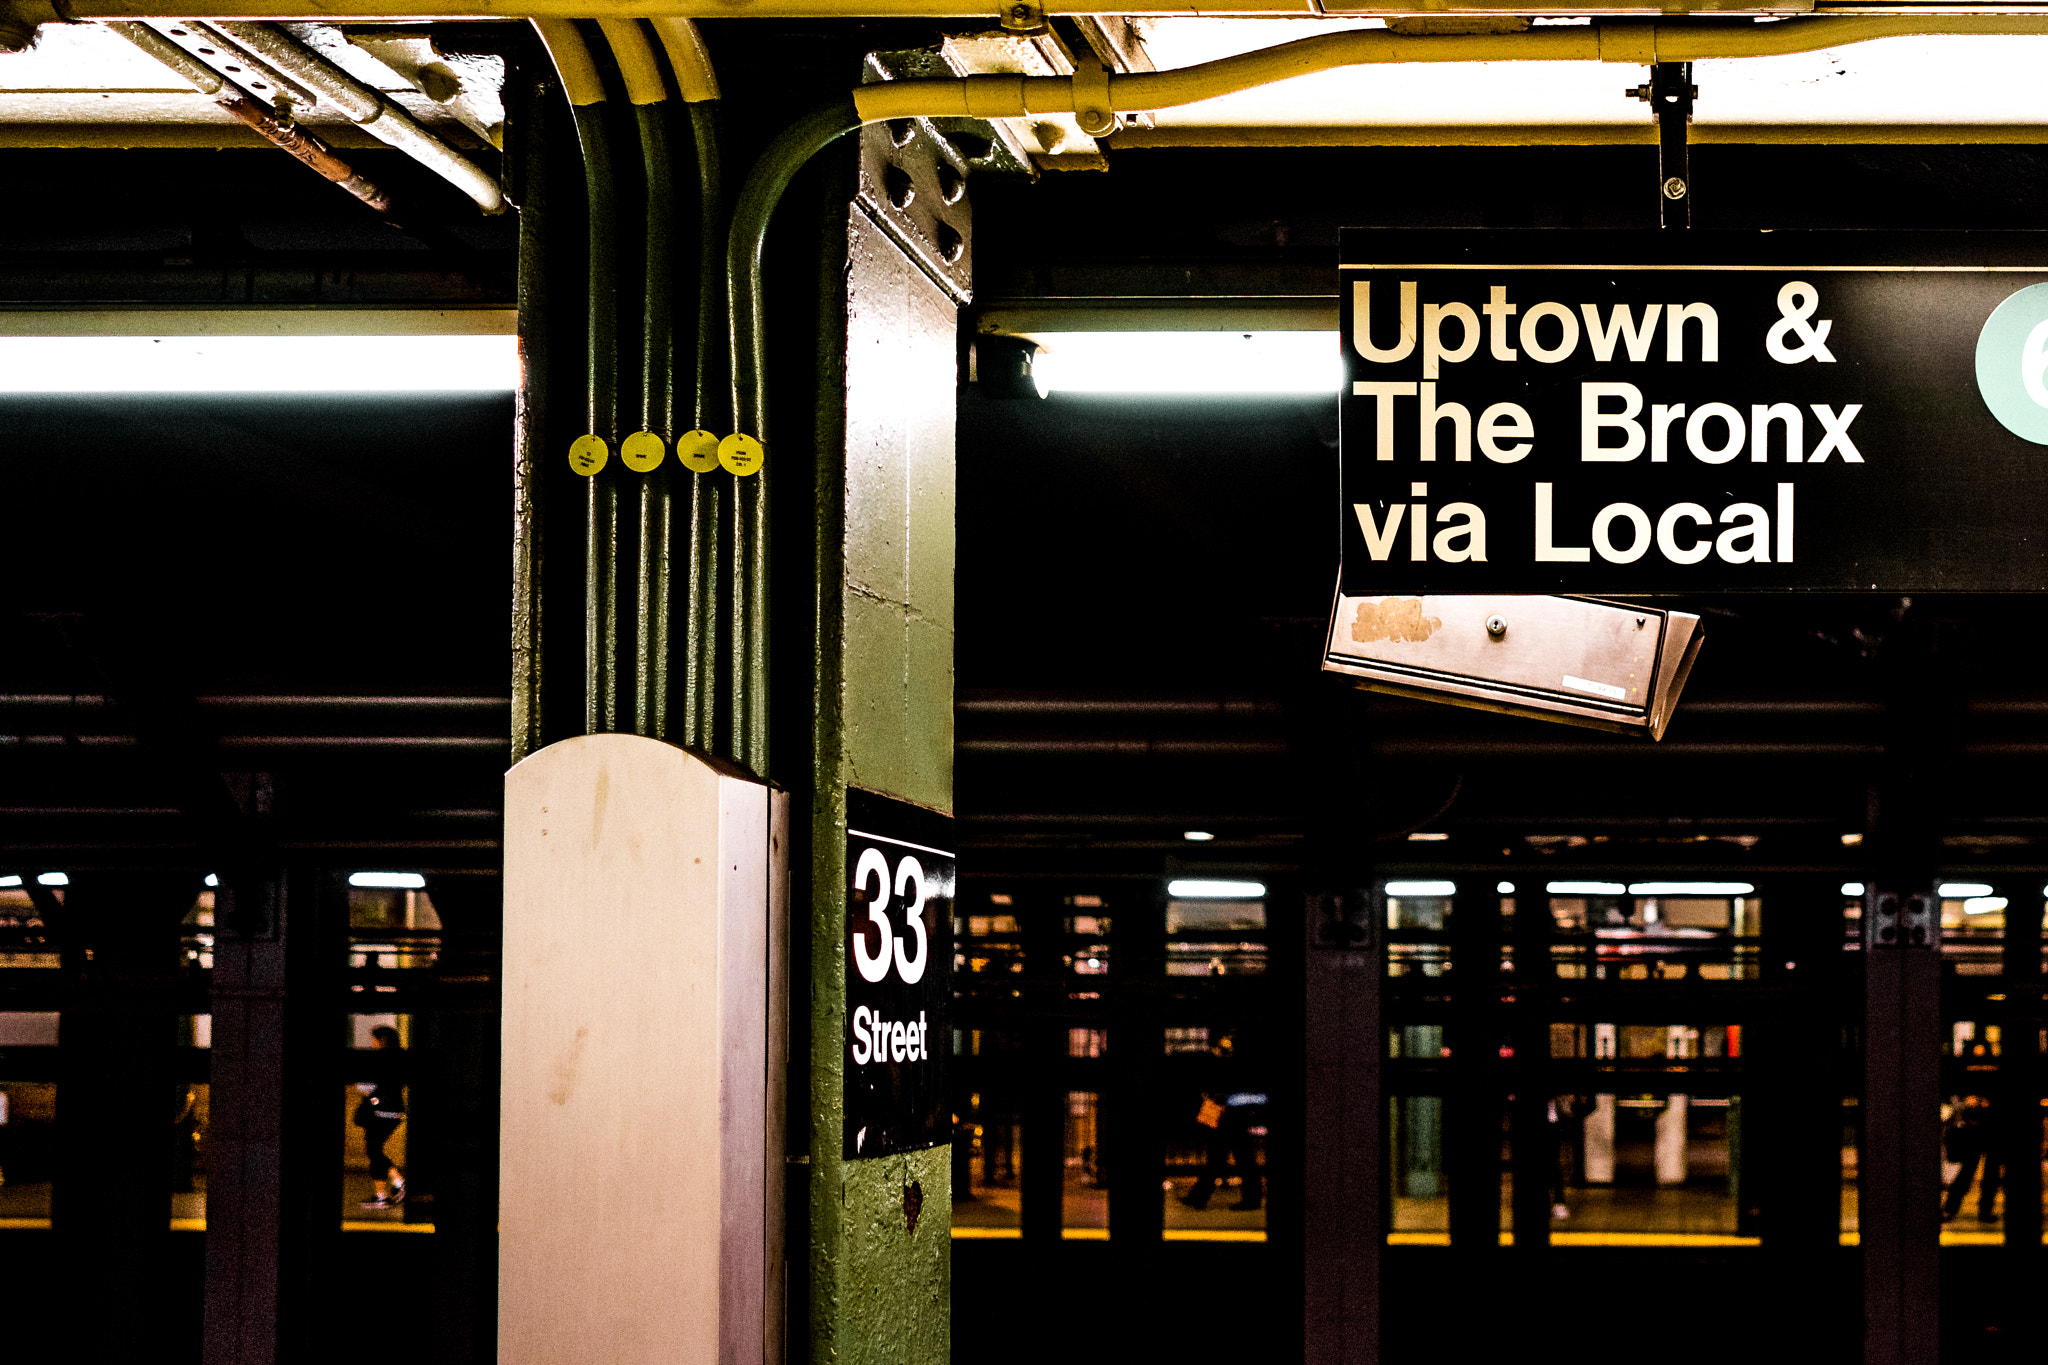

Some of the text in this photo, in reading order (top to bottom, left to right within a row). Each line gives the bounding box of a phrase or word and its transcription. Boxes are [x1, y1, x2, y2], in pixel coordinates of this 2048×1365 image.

[1353, 281, 1837, 380] Uptown &
[1353, 381, 1865, 465] The Bronx
[1353, 482, 1795, 565] via Local
[853, 847, 928, 985] 33
[852, 1004, 928, 1065] Street
